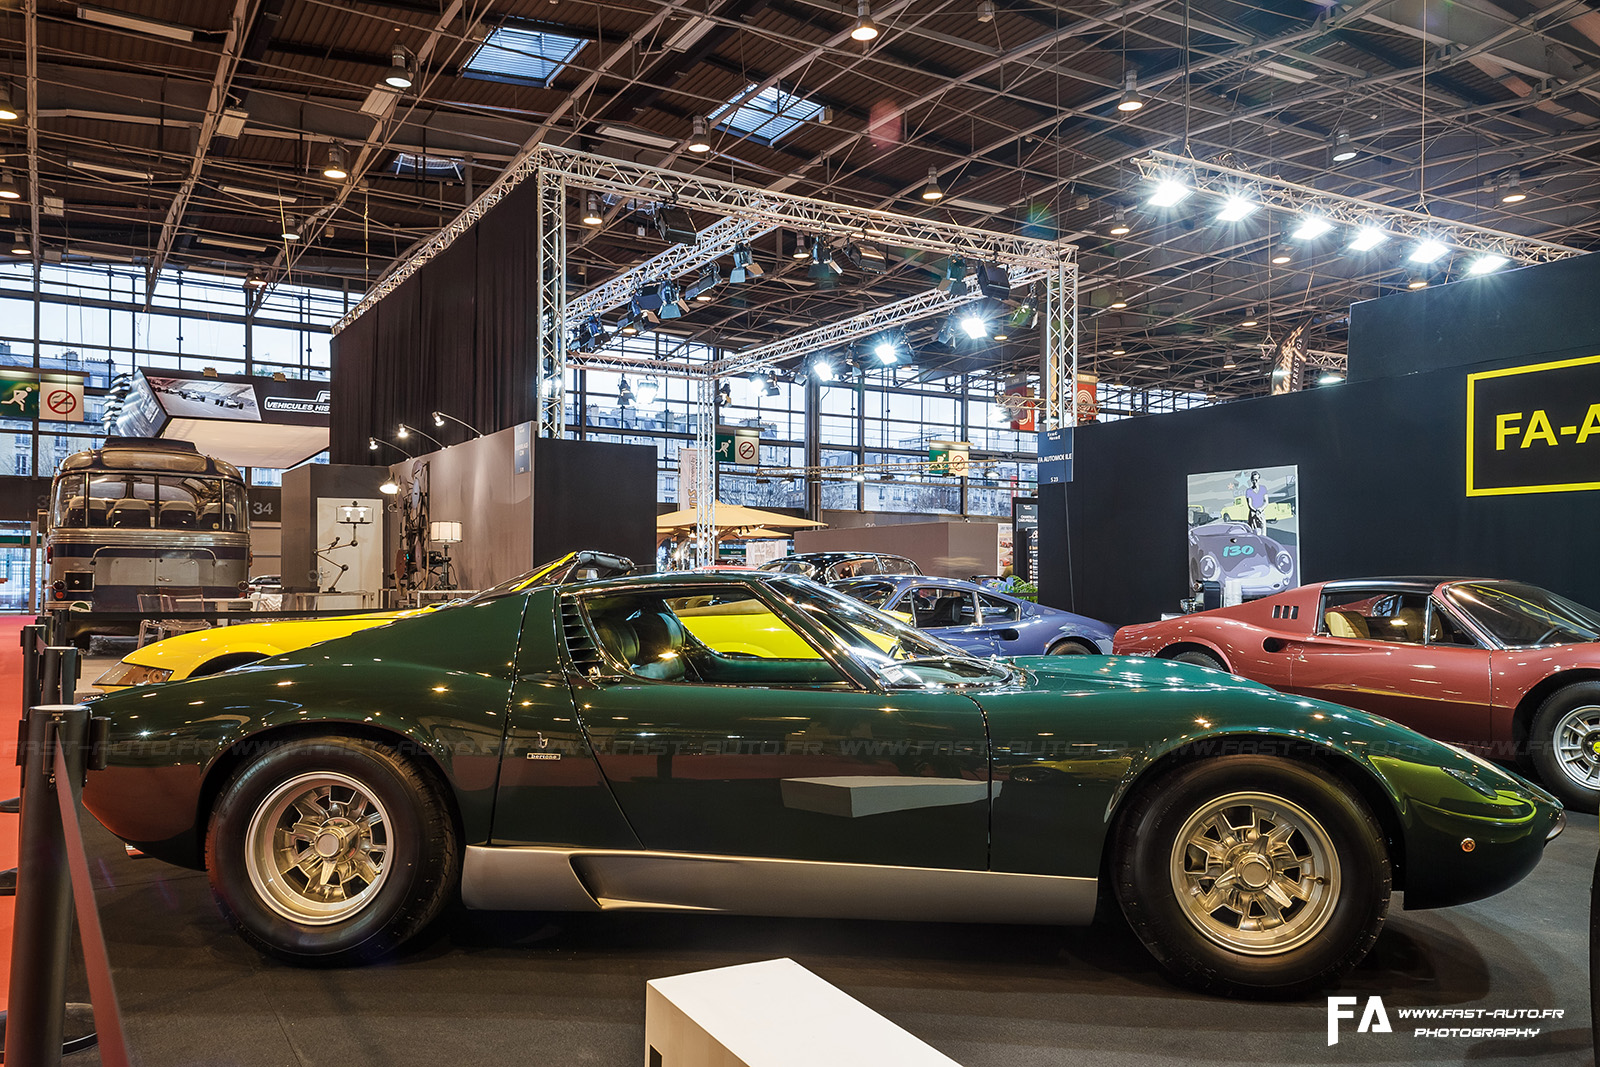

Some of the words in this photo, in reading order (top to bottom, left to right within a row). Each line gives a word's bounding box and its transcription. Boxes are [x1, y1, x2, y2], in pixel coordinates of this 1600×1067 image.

[267, 401, 314, 411] VEHICULES
[253, 502, 273, 515] 34
[1223, 545, 1254, 557] 130
